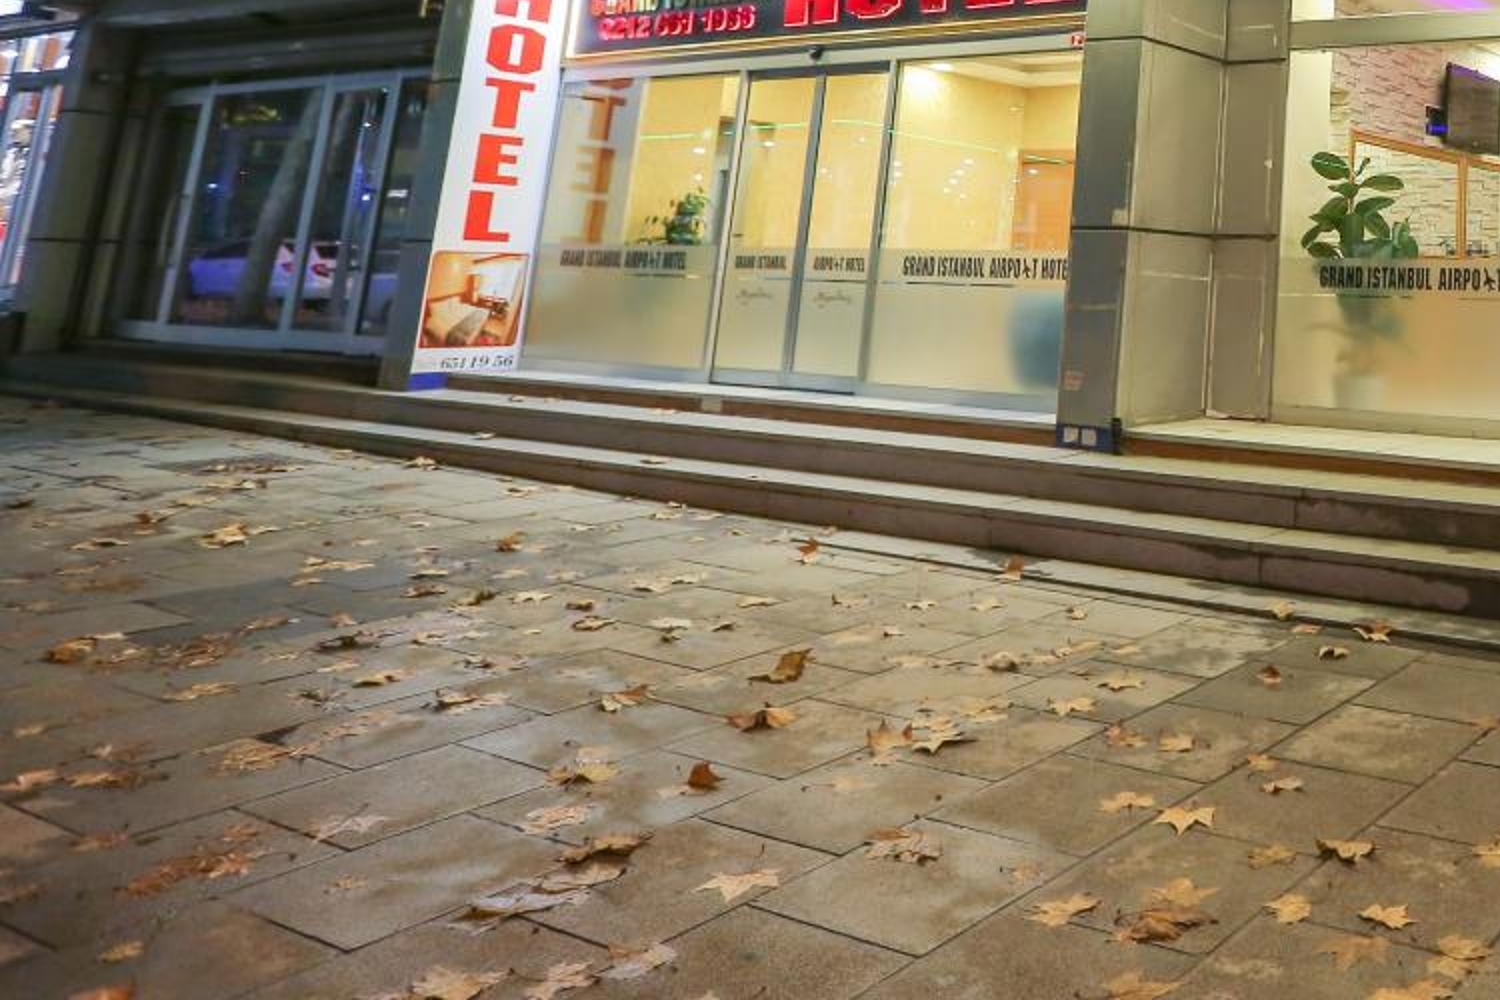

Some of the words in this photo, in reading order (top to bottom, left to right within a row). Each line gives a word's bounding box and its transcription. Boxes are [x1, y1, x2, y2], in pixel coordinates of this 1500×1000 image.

[903, 256, 935, 276] GRAND
[937, 257, 984, 278] ISTANBUL
[1041, 259, 1069, 281] HOTE
[1319, 266, 1364, 289] GRAND
[1366, 267, 1432, 290] ISTANBUL
